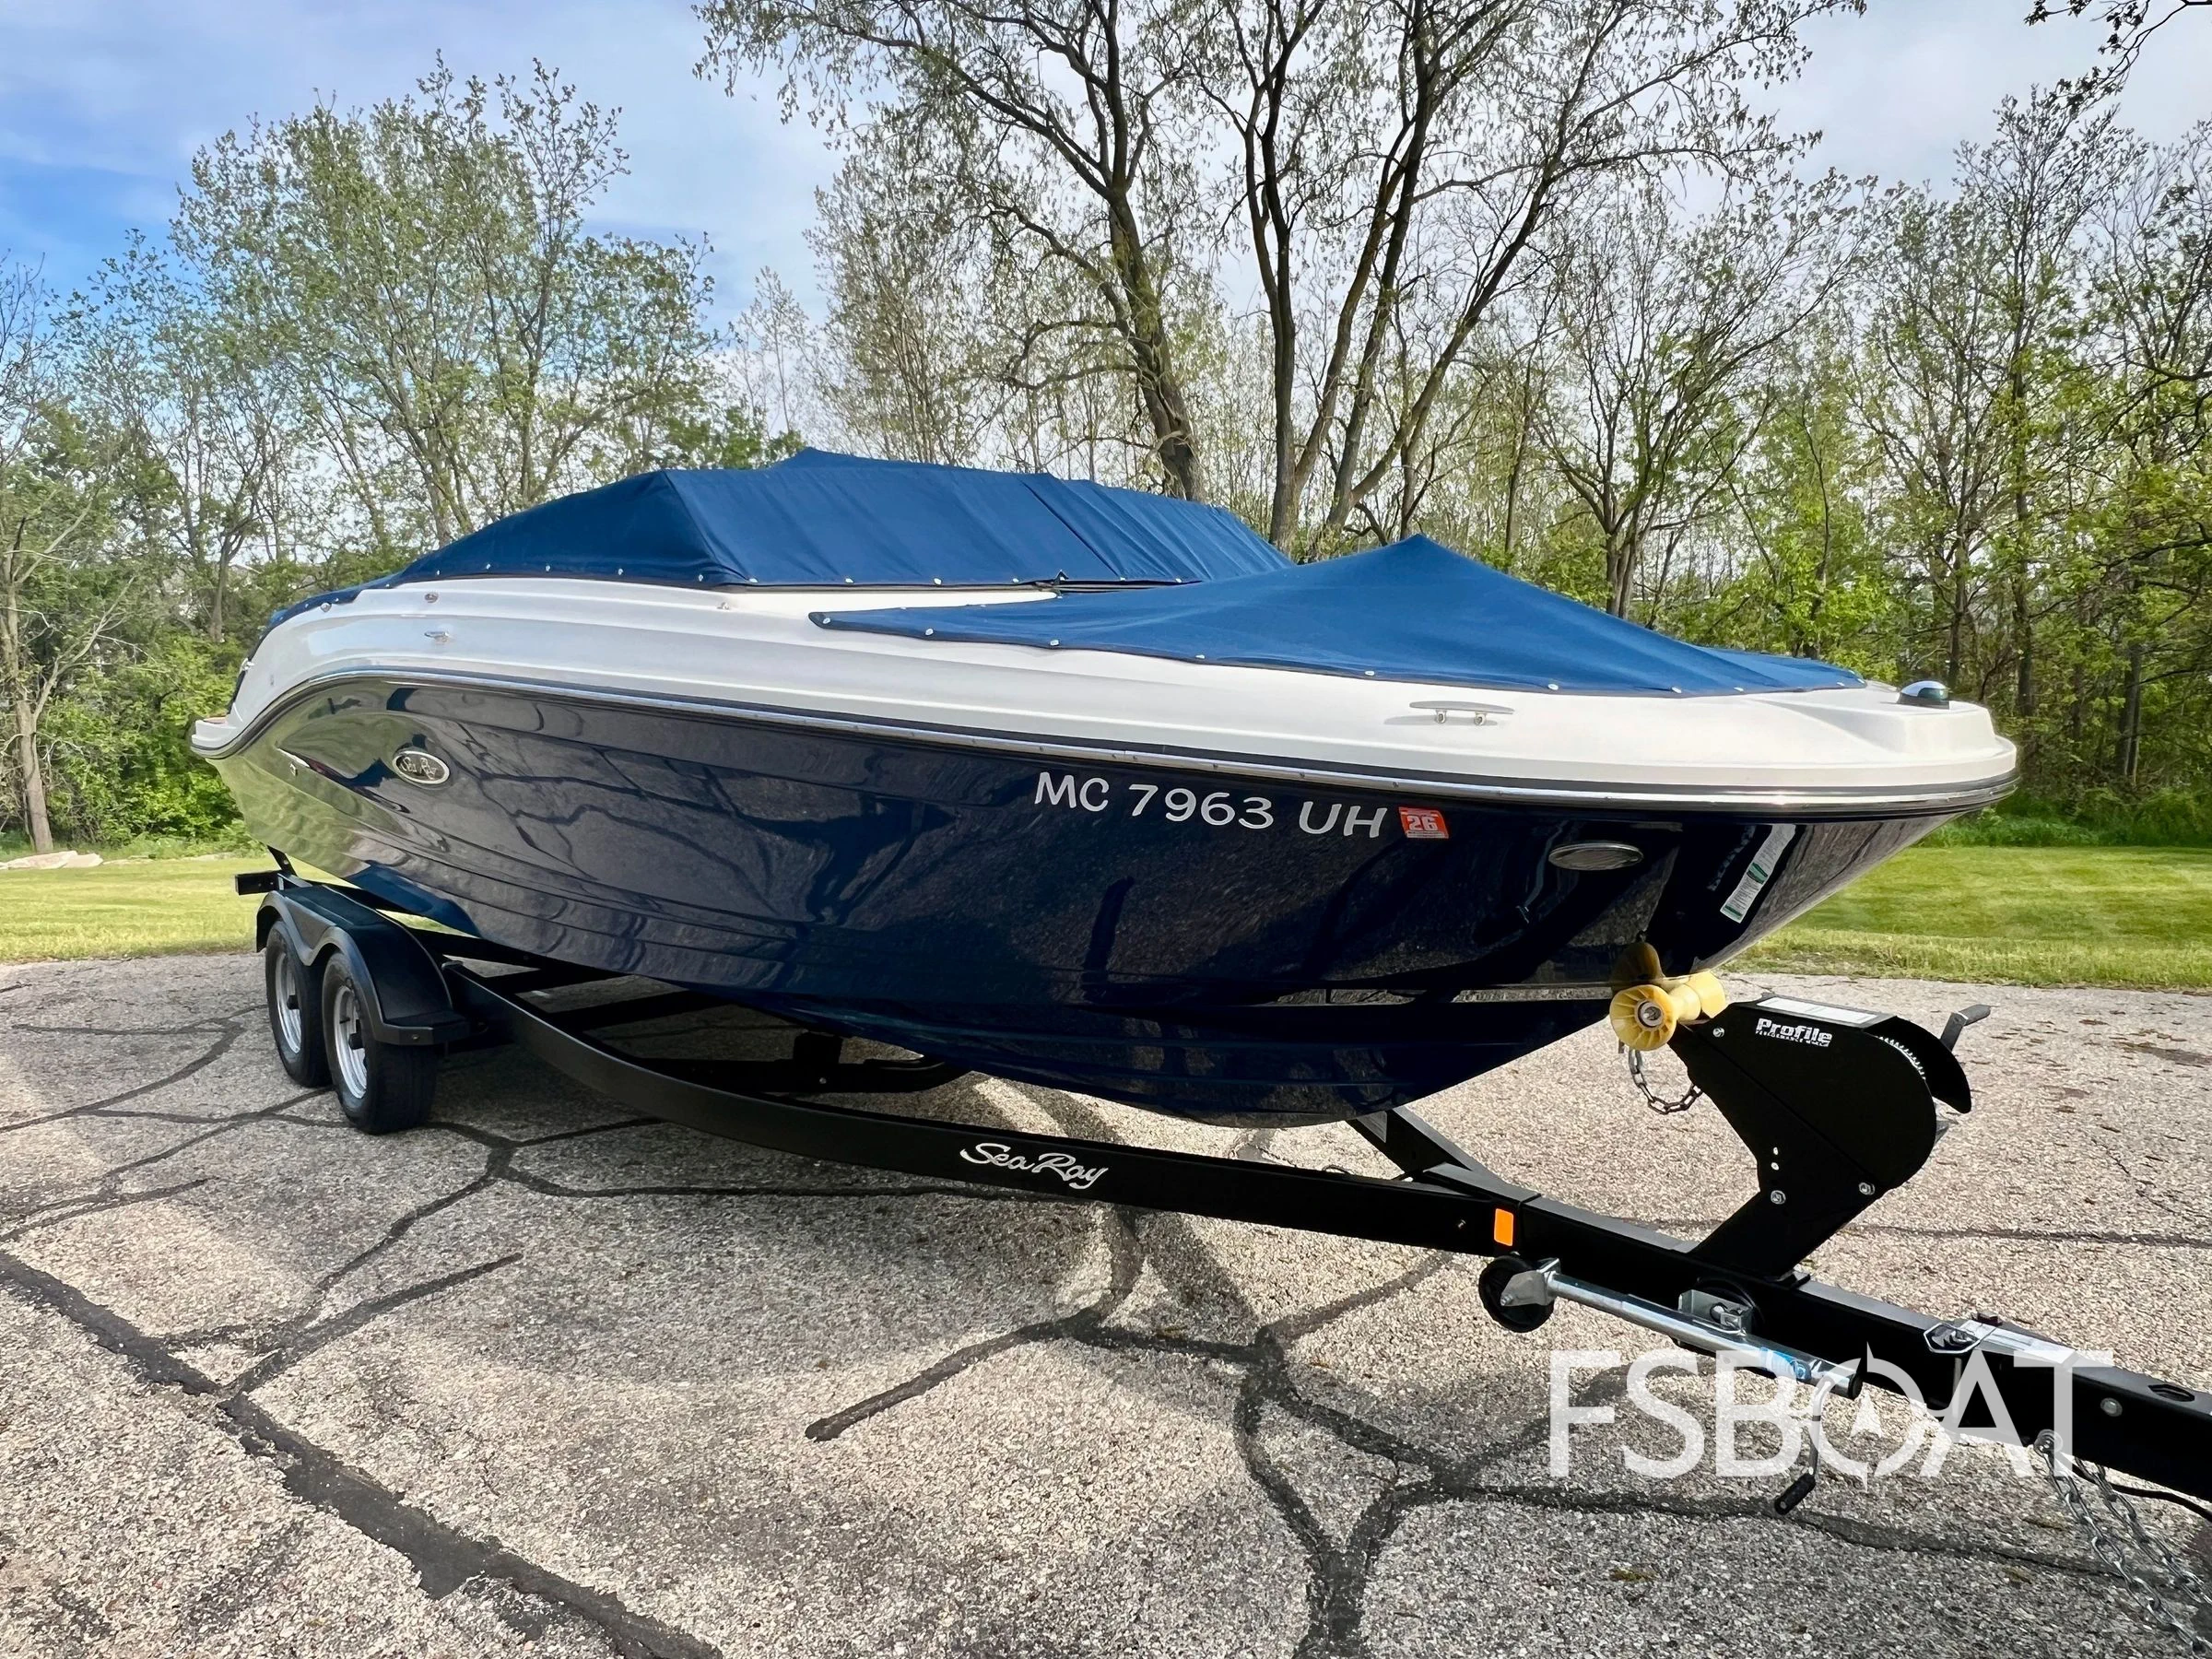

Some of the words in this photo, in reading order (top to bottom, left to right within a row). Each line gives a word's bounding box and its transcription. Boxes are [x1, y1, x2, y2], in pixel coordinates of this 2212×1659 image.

[1034, 771, 1110, 812] MC
[1128, 783, 1274, 830] 7963
[1299, 801, 1388, 839] UH
[1406, 815, 1439, 831] 26
[1756, 1018, 1832, 1043] Profile
[959, 1142, 1035, 1171] Sea
[1031, 1152, 1109, 1190] Ray
